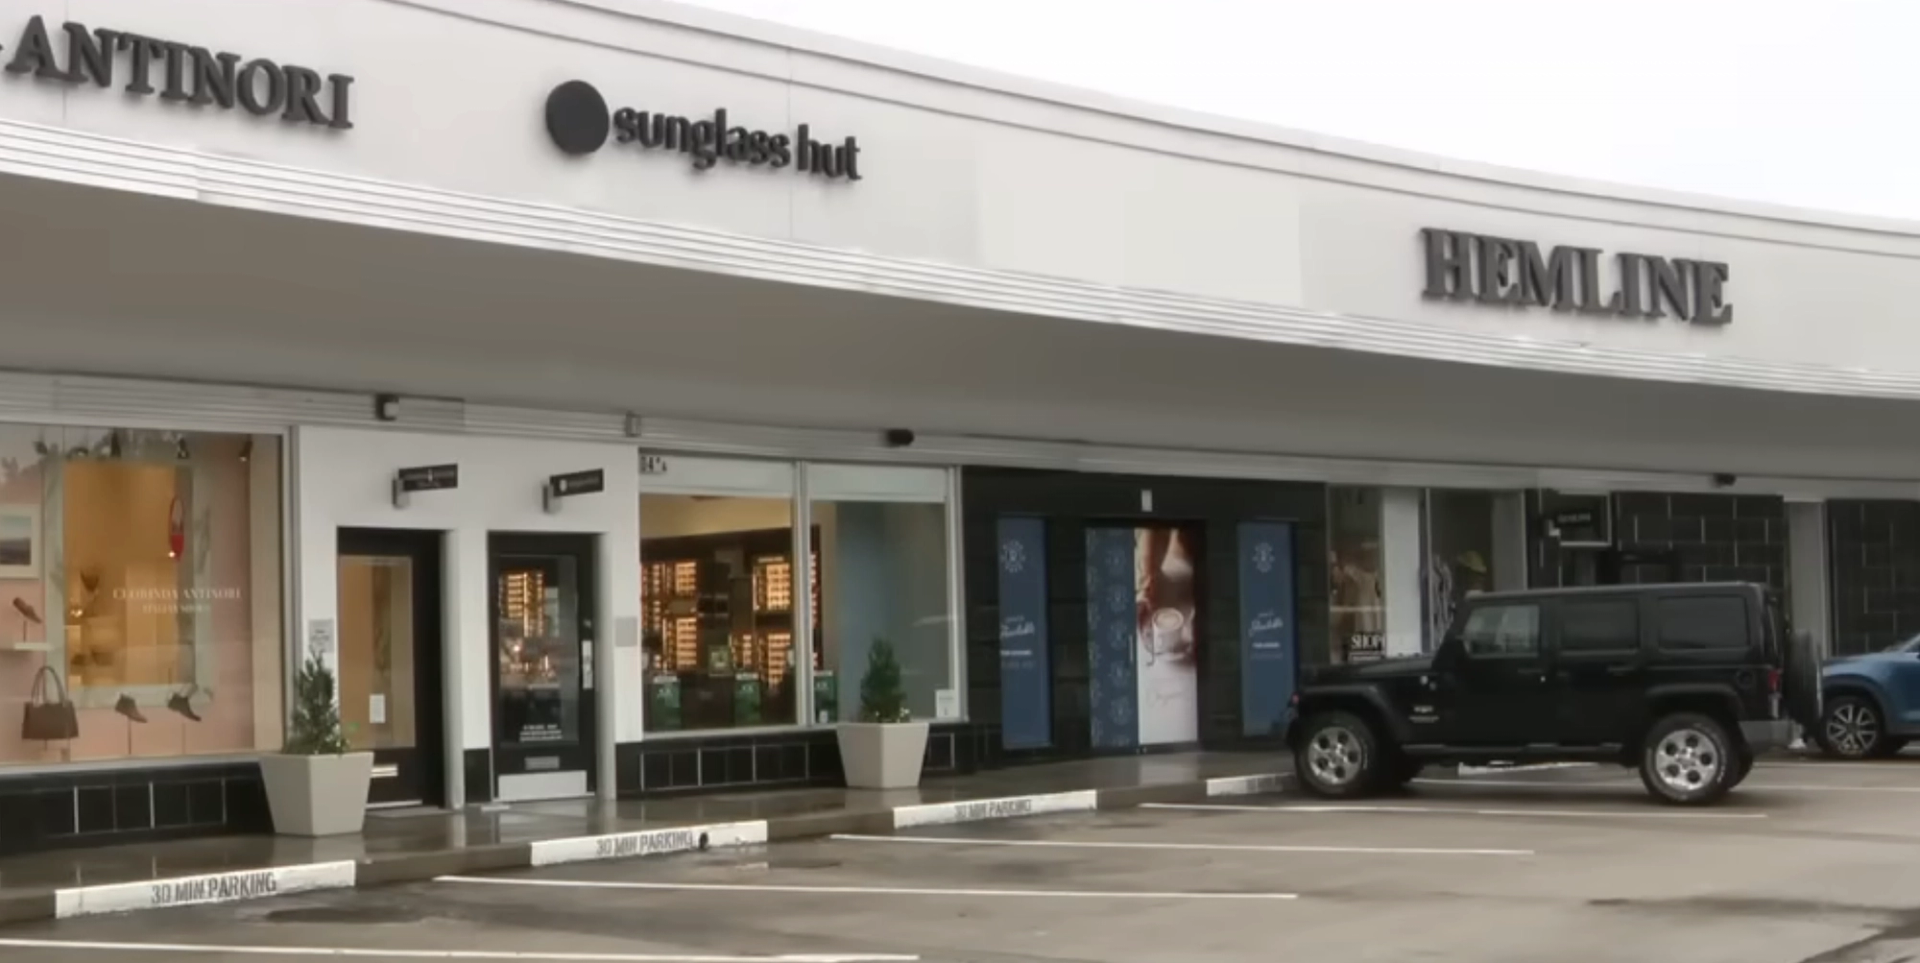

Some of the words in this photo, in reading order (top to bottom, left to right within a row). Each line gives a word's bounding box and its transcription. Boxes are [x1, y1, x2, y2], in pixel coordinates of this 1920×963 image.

[5, 15, 354, 128] ANTINORI
[613, 107, 790, 169] sunglass
[797, 123, 862, 180] hut
[1420, 227, 1733, 324] HEMLINE
[597, 838, 613, 855] 30
[614, 835, 638, 853] MIN
[640, 830, 692, 852] PARKING
[152, 884, 171, 903] 30
[175, 879, 205, 901] MIN
[208, 872, 277, 898] PARKING
